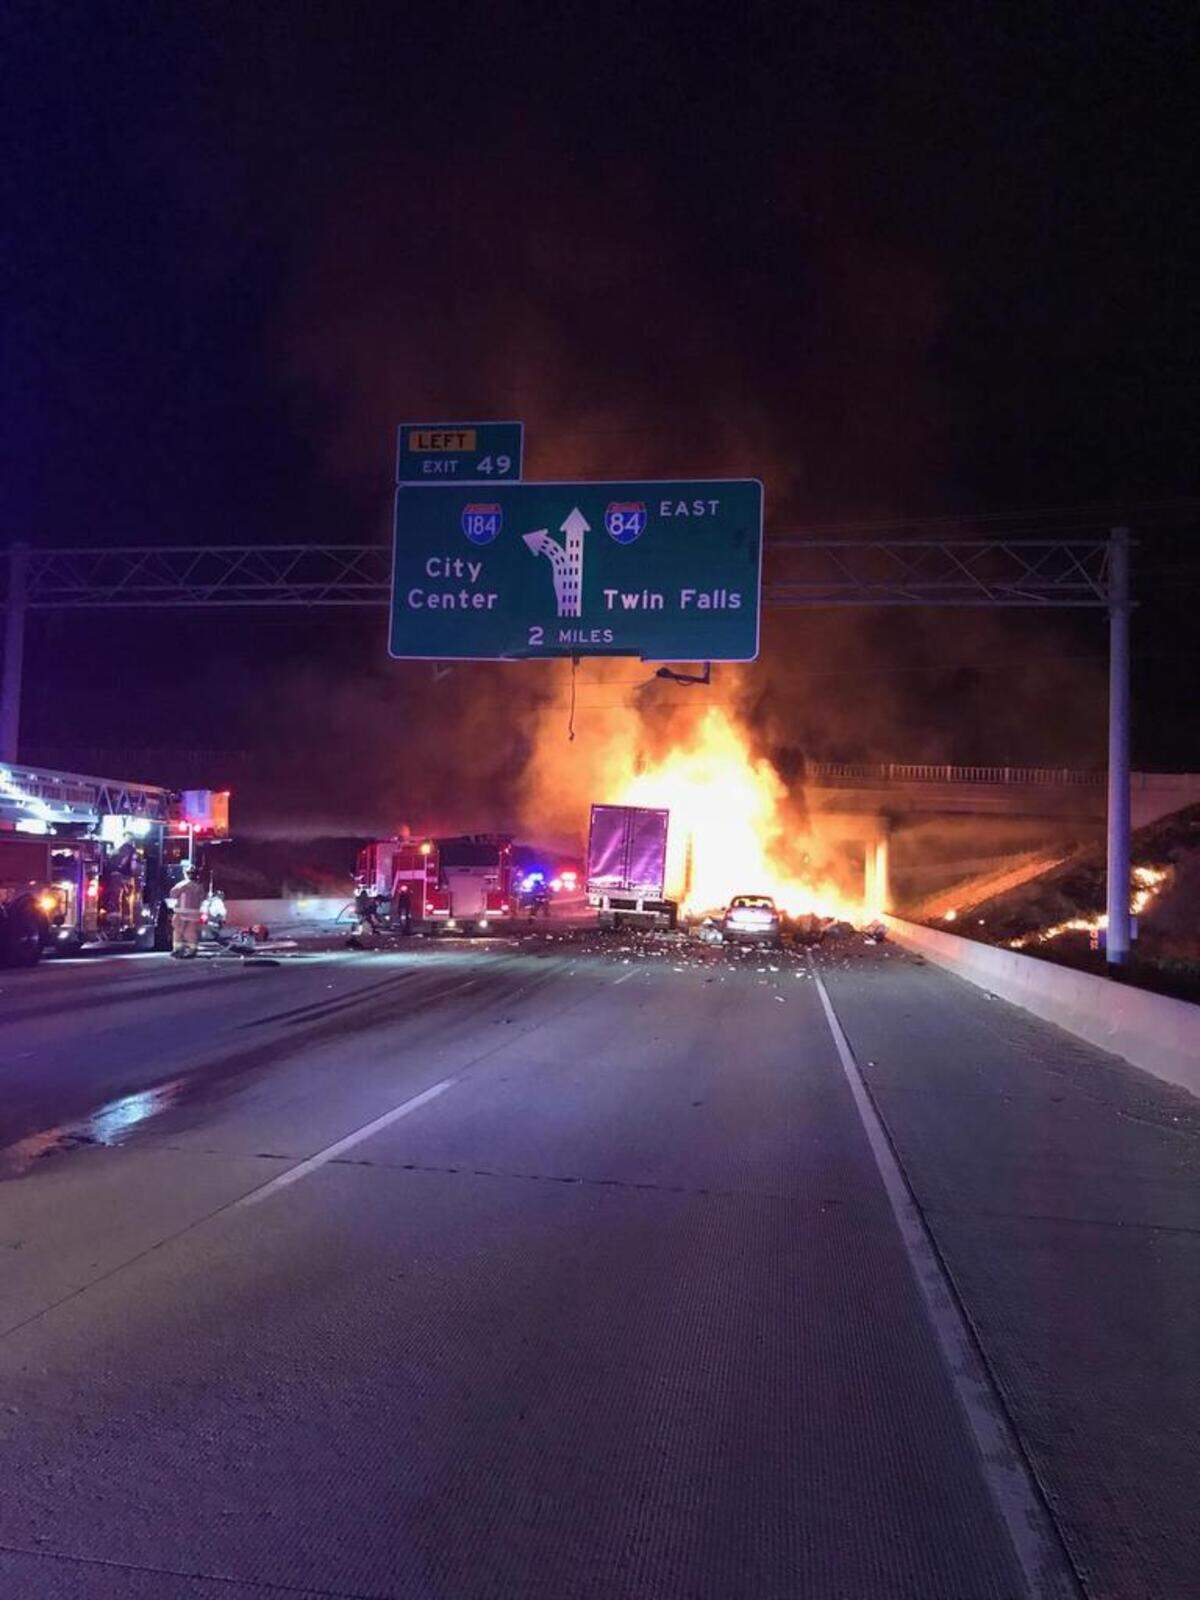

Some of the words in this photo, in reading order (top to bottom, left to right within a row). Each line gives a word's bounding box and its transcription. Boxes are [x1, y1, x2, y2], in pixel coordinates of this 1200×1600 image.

[417, 433, 467, 449] LEFT
[423, 460, 458, 473] EXIT
[476, 454, 511, 474] 49
[660, 500, 720, 516] EAST
[468, 515, 496, 535] 184
[610, 512, 640, 535] 84
[426, 557, 482, 583] City
[408, 588, 498, 609] Center
[603, 589, 664, 610] Twin
[680, 589, 742, 610] Falls
[528, 626, 544, 646] 2
[558, 629, 614, 643] MILES
